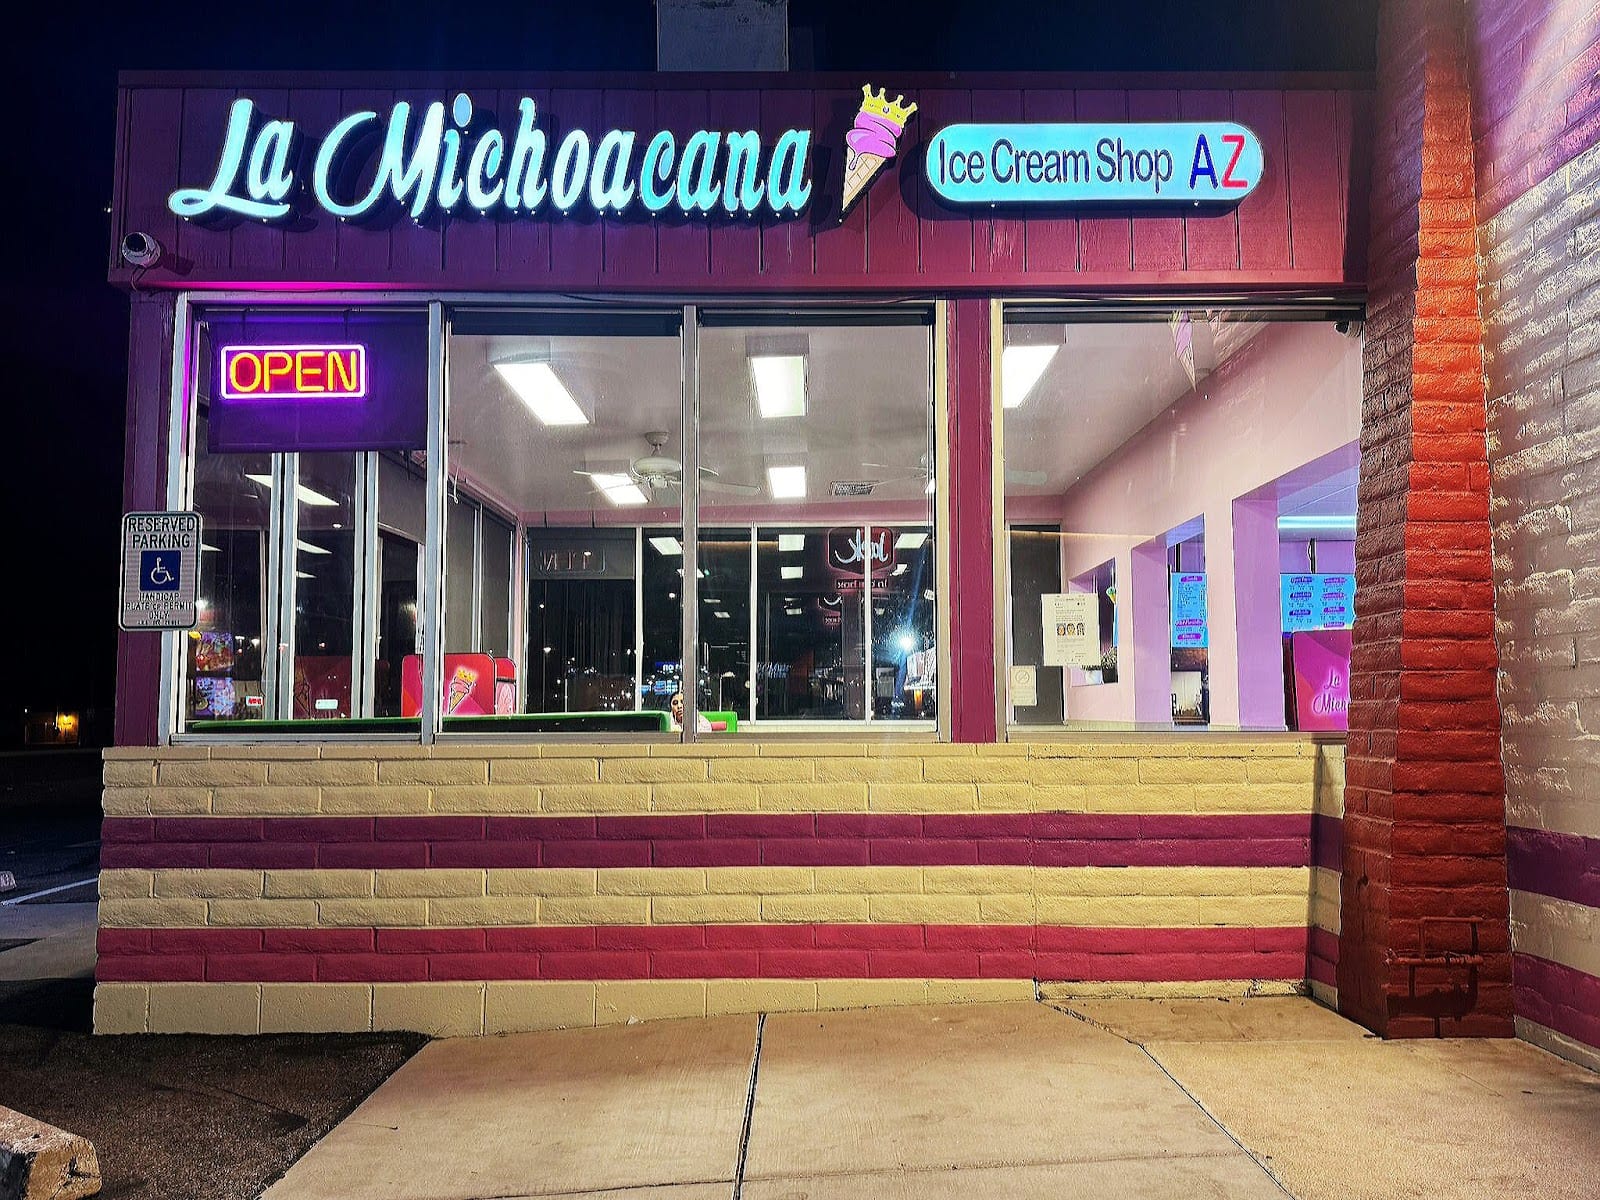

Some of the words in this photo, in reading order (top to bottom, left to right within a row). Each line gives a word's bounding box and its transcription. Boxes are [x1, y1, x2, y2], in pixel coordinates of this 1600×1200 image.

[168, 97, 294, 218] La
[313, 93, 812, 219] Michoacana
[939, 138, 984, 185] Ice
[991, 138, 1089, 185] Cream
[1096, 138, 1173, 194] Shop
[1189, 133, 1248, 189] AZ
[228, 350, 358, 393] OPEN
[128, 517, 195, 532] RESERVED
[132, 534, 190, 549] PARKING
[139, 592, 180, 601] HANDICAP
[163, 601, 193, 610] PERMIT
[148, 610, 170, 620] ONLY
